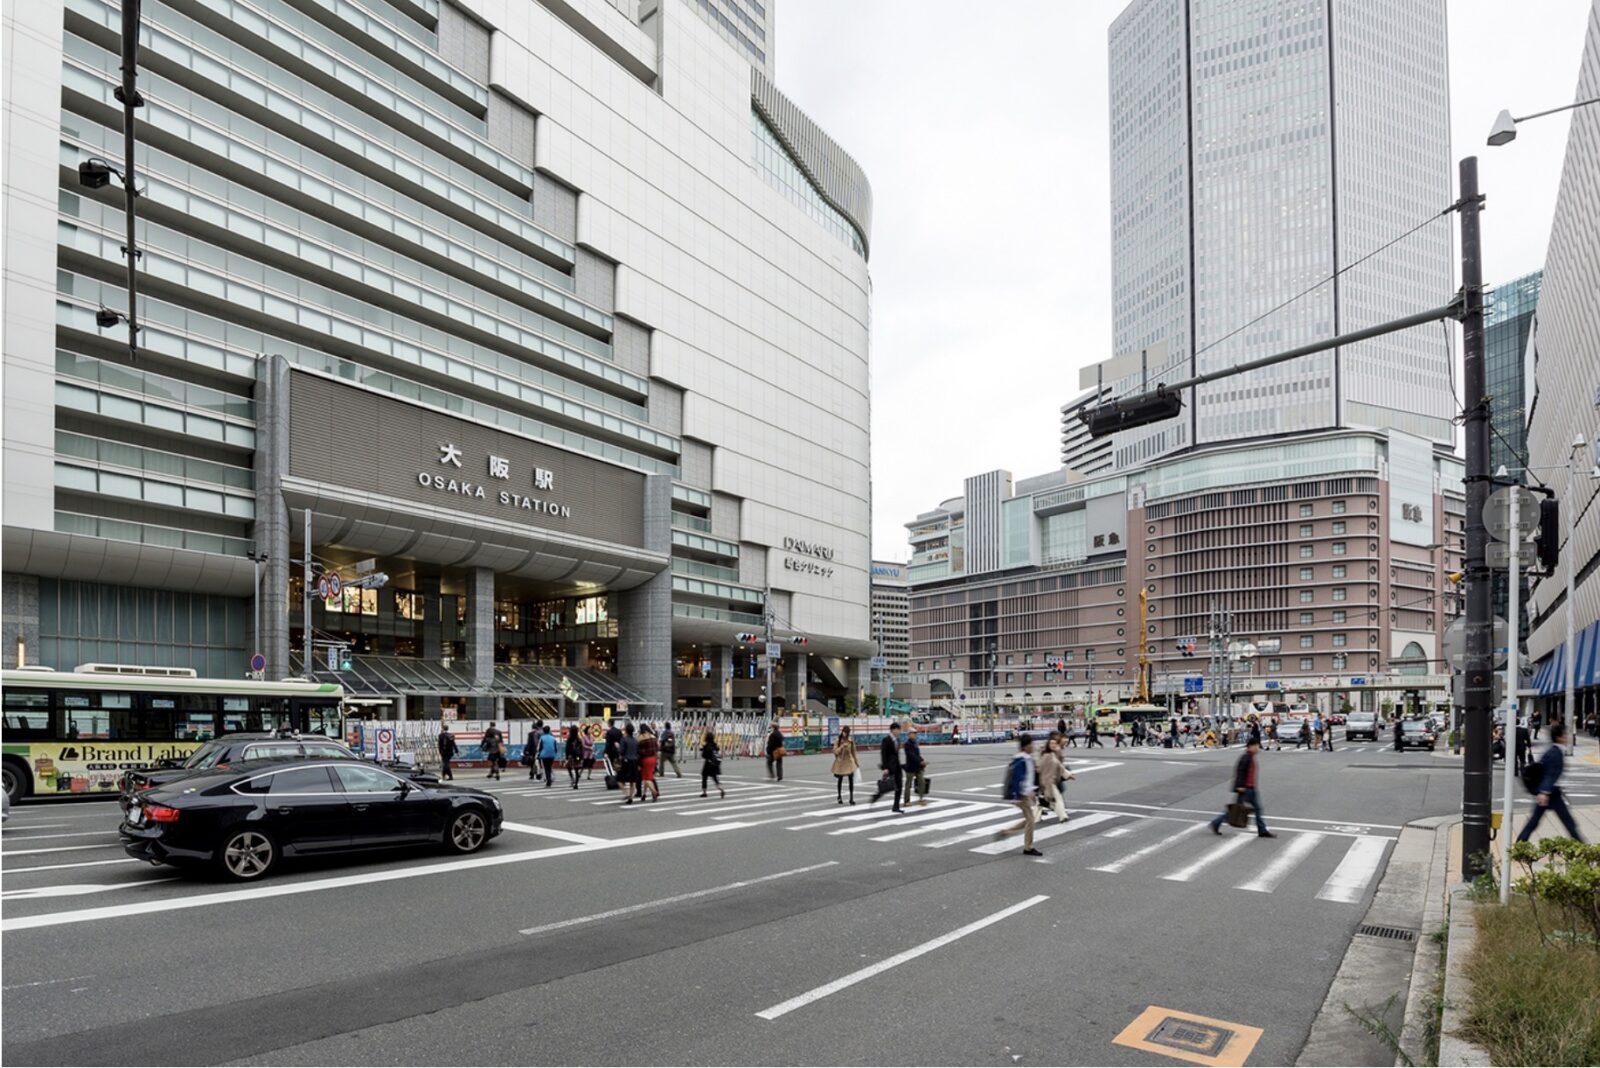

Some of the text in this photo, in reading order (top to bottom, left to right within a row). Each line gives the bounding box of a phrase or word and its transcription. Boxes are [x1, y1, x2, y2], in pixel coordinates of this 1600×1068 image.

[440, 444, 554, 490] 大阪駅
[418, 472, 570, 518] OSAKA STATION
[1093, 532, 1120, 548] 阪急
[81, 745, 195, 761] Brand Labo
